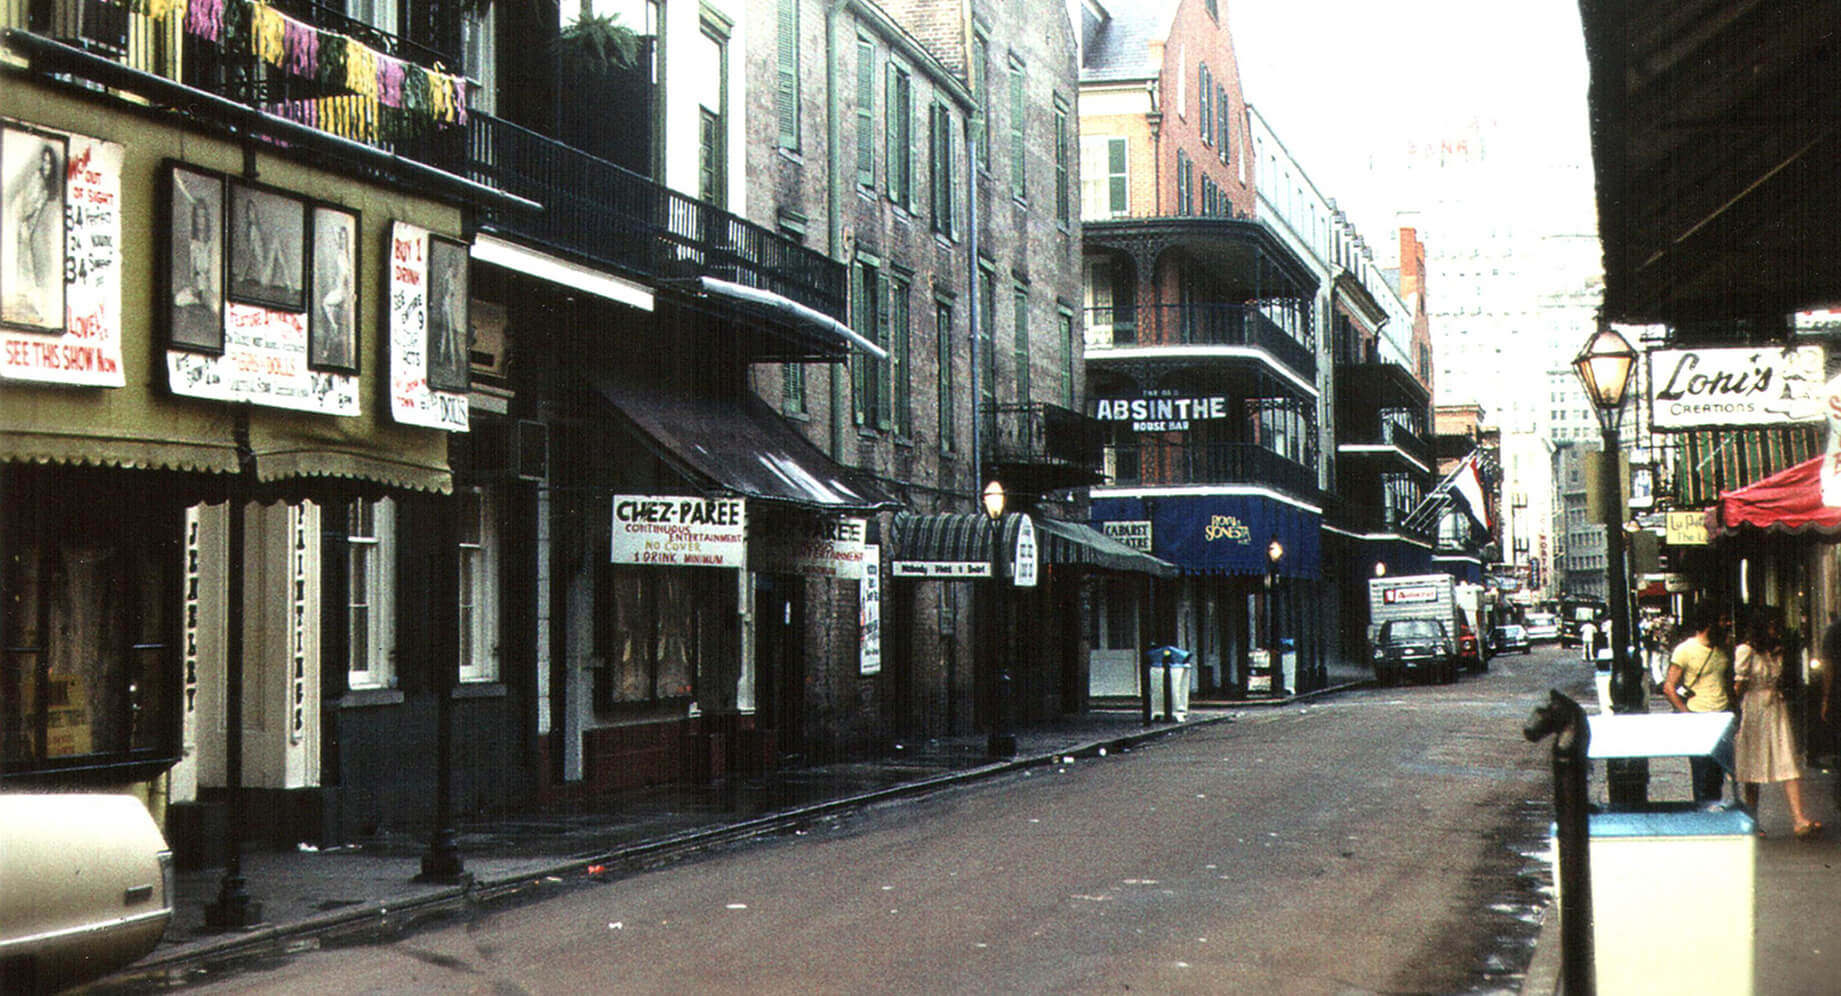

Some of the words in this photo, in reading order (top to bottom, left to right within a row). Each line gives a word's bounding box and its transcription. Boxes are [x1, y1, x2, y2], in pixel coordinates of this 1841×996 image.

[395, 238, 411, 262] BUY
[396, 265, 421, 286] DRINK
[6, 340, 30, 366] SEE
[32, 342, 60, 369] THIS
[63, 345, 94, 371] SHOW
[1656, 352, 1774, 400] Loni's
[1097, 397, 1227, 421] ABSINTHE
[1132, 421, 1166, 432] HOUSE
[1168, 421, 1190, 431] BAR
[616, 500, 740, 526] CHEZ-PAREE
[625, 523, 690, 534] CONTINUOUS
[669, 532, 742, 544] ENTERTAINMENT
[1106, 525, 1150, 537] CABARET
[1205, 525, 1252, 542] SONESTA
[645, 541, 660, 551] NO
[664, 541, 702, 553] COVER
[643, 551, 676, 563] DRINK
[684, 553, 724, 565] MINIMUM
[188, 521, 198, 713] JEWELRY
